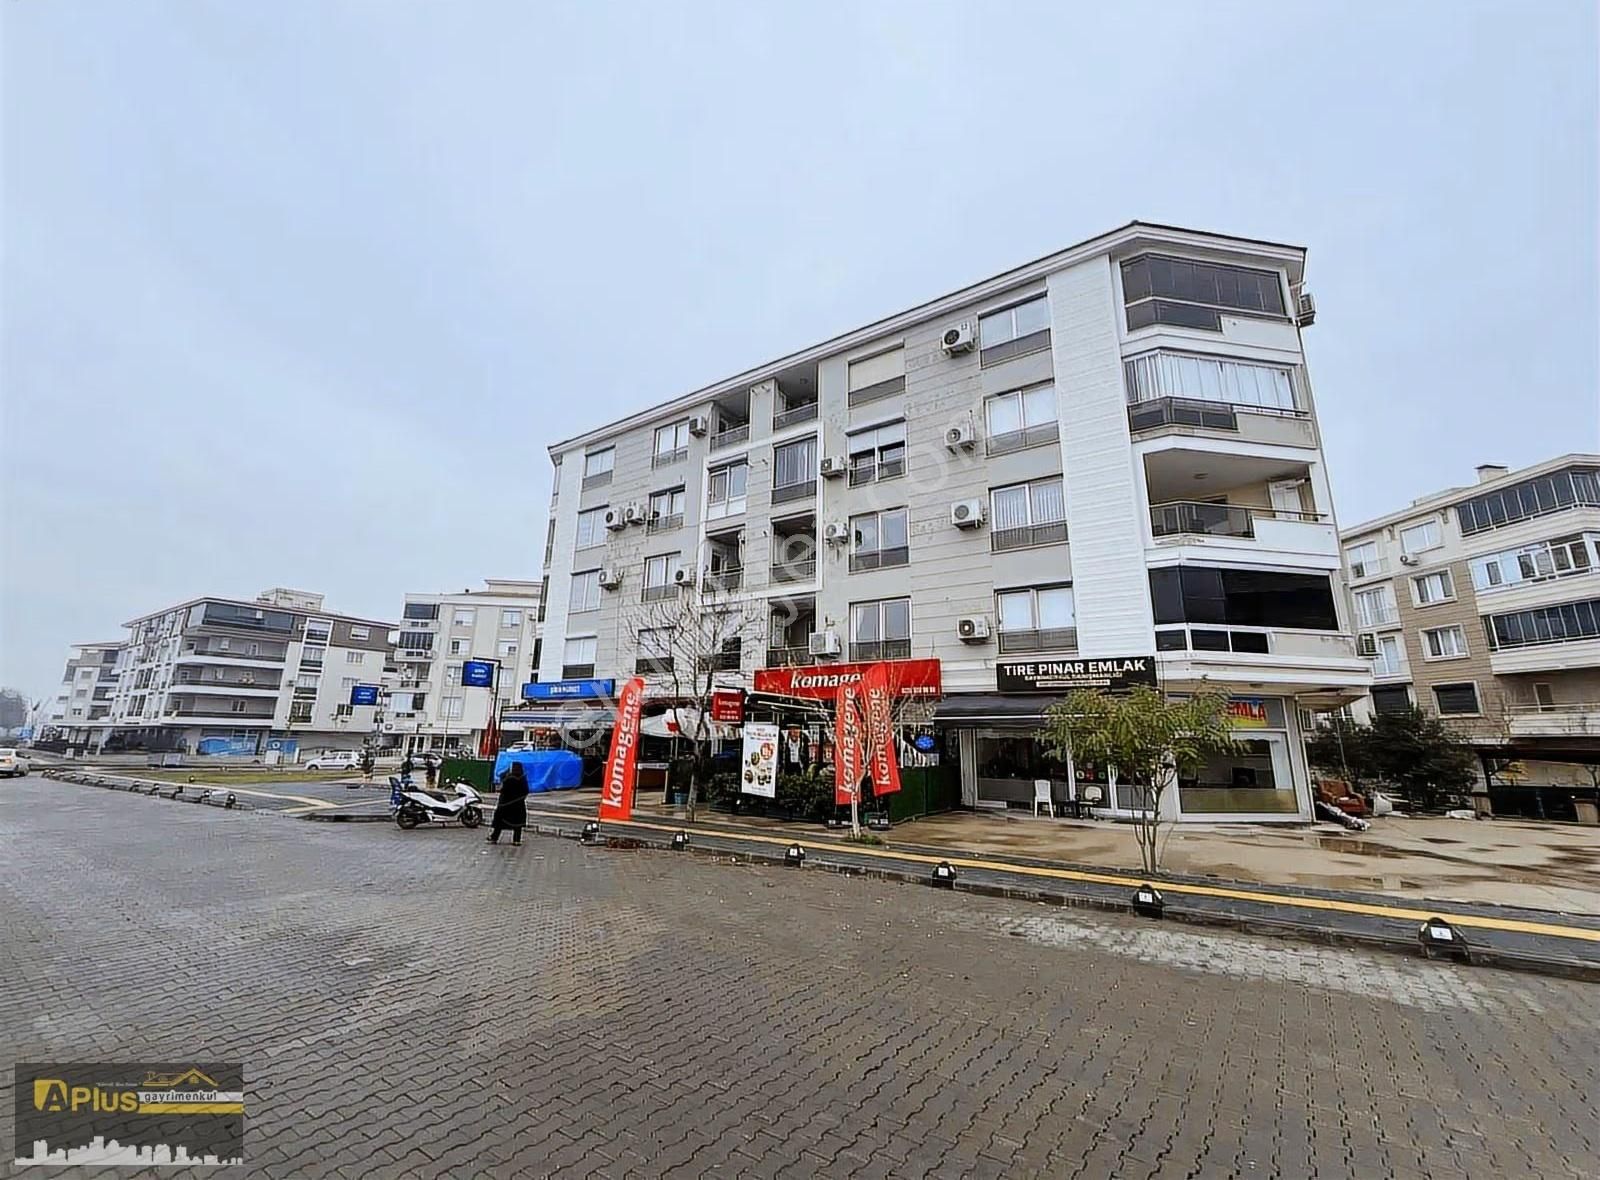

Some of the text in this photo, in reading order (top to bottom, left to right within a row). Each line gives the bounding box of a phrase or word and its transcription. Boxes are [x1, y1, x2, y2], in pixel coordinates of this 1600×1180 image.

[1038, 662, 1084, 675] PINAR
[1088, 659, 1146, 673] EMLAK
[791, 670, 862, 688] komage
[602, 691, 639, 808] komagene
